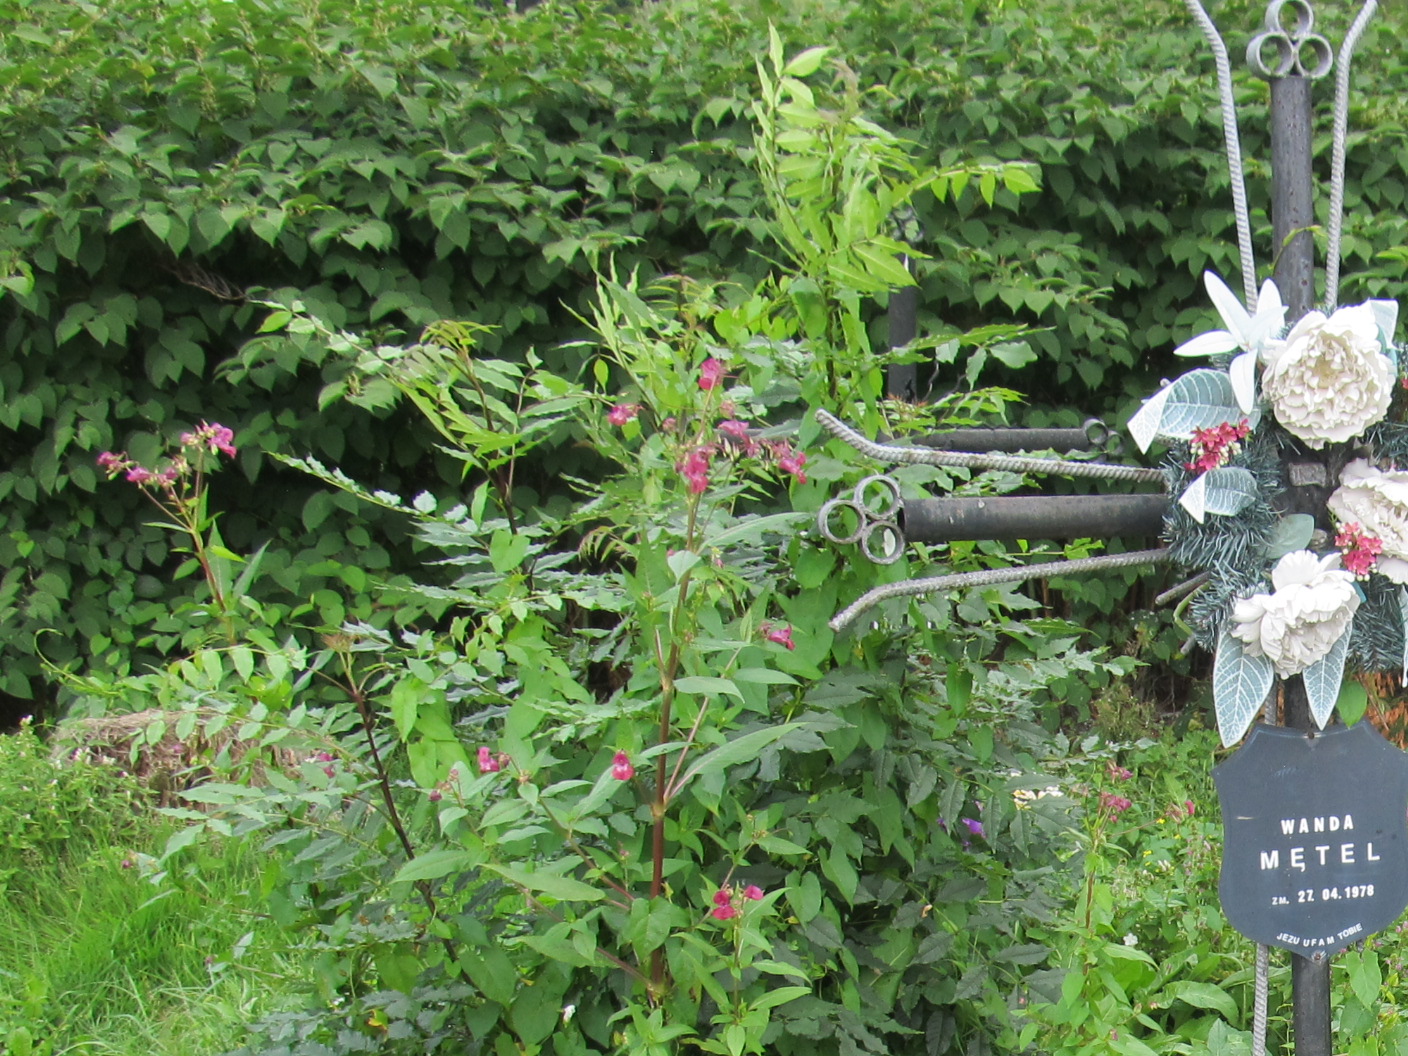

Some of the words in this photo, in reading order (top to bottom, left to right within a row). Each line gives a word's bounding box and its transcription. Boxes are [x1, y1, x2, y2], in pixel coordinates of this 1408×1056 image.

[1280, 814, 1354, 835] WANDA
[1260, 842, 1381, 872] MĘTEL
[1276, 932, 1301, 945] JEZU
[1302, 935, 1335, 948] UFAM
[1337, 922, 1363, 940] TOBIE
